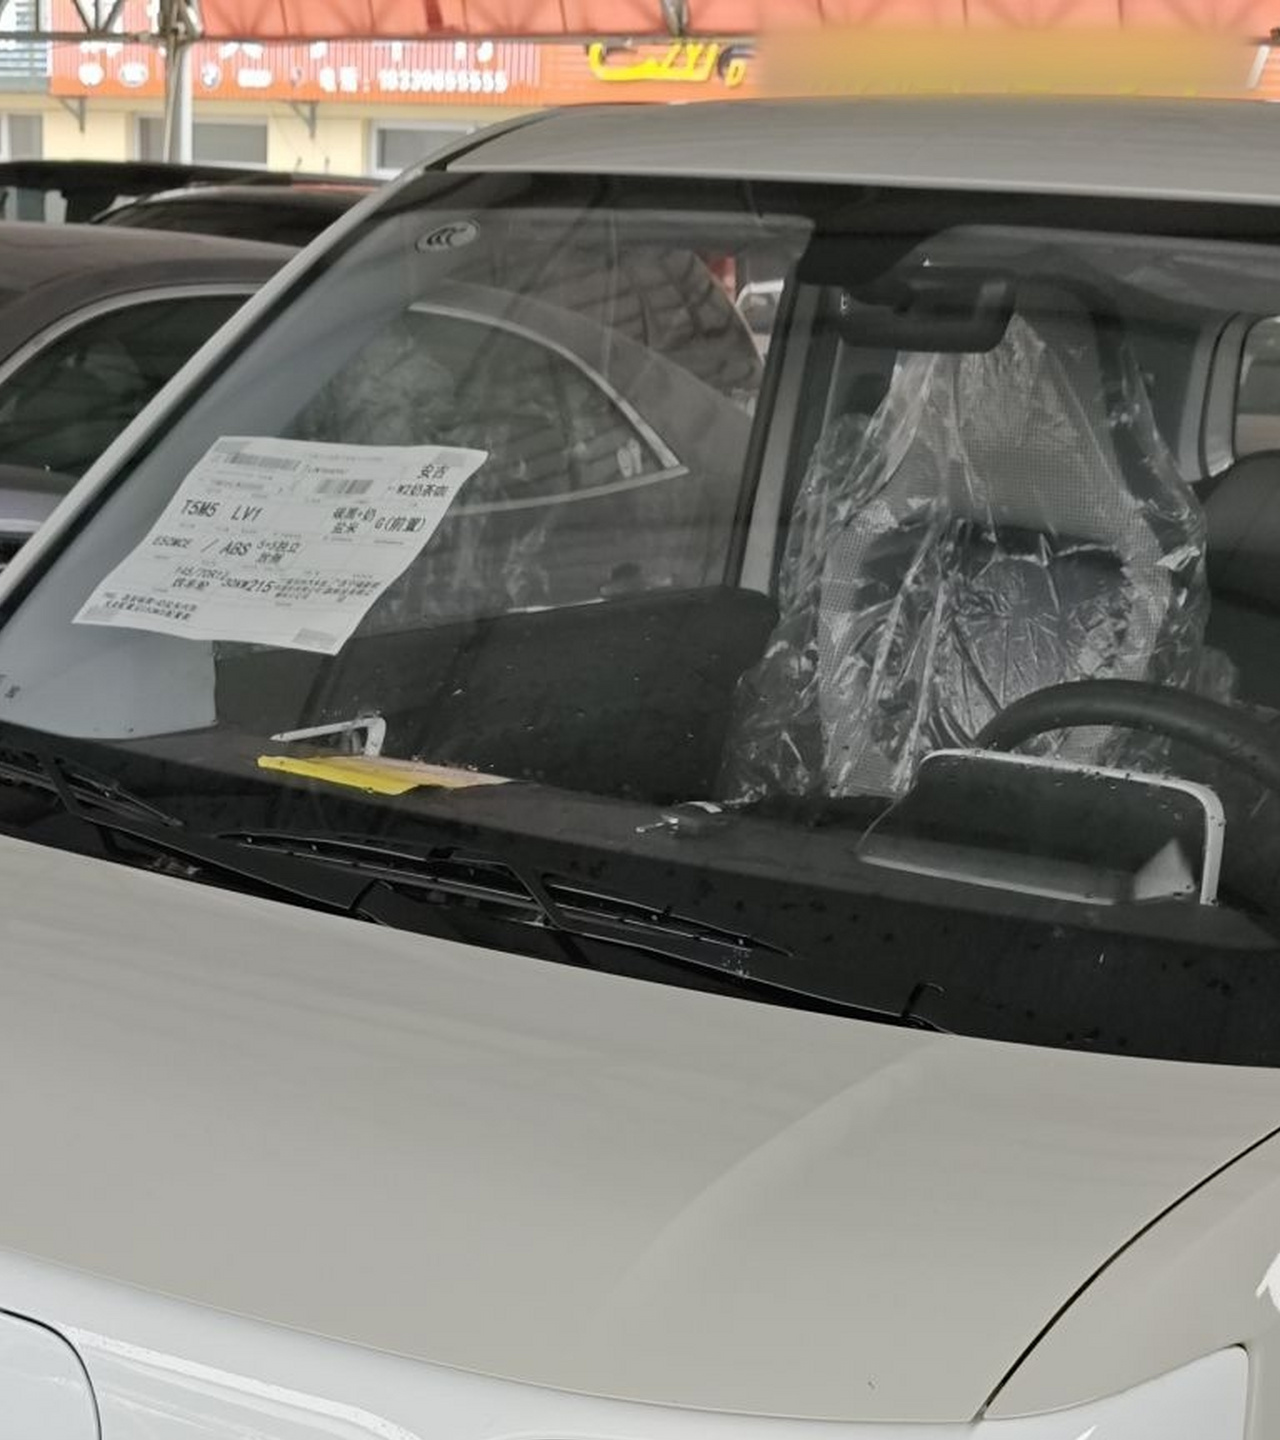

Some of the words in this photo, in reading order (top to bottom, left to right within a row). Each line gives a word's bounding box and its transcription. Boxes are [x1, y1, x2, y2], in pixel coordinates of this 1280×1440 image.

[179, 499, 220, 519] T5M5
[230, 505, 264, 523] LV1
[218, 541, 253, 557] ABS
